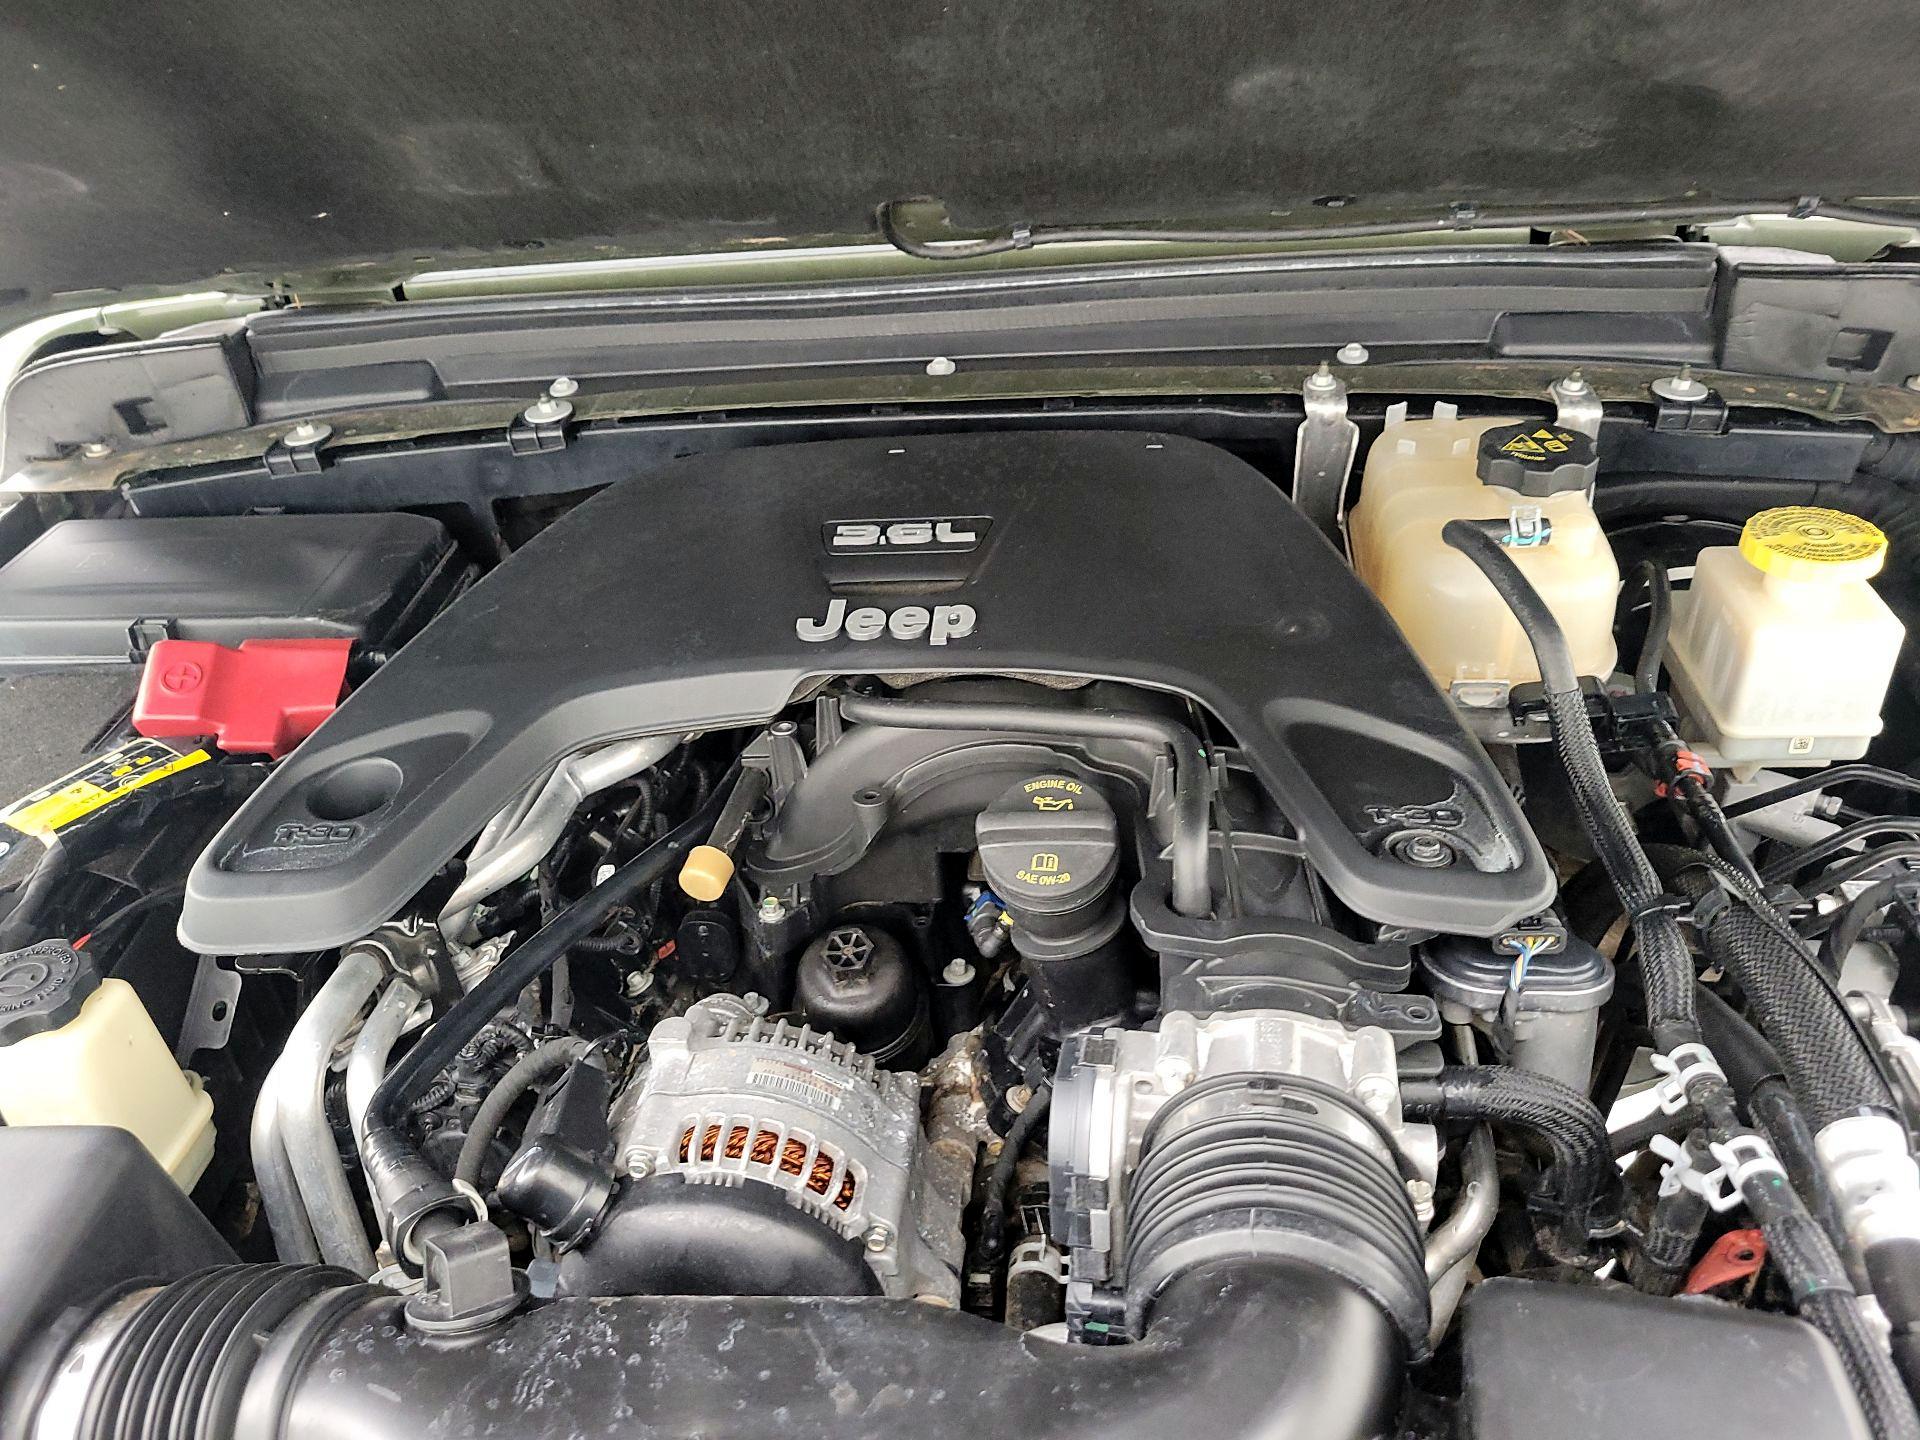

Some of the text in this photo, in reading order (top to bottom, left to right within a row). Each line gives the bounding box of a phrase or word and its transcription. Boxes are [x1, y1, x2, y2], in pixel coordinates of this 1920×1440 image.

[832, 521, 977, 546] 3.6L
[795, 599, 977, 646] Jeep
[1023, 779, 1083, 795] ENGINE OIL
[1015, 870, 1071, 886] SAE 0W-20
[24, 945, 72, 965] APPROVED
[34, 977, 65, 1001] FLUID
